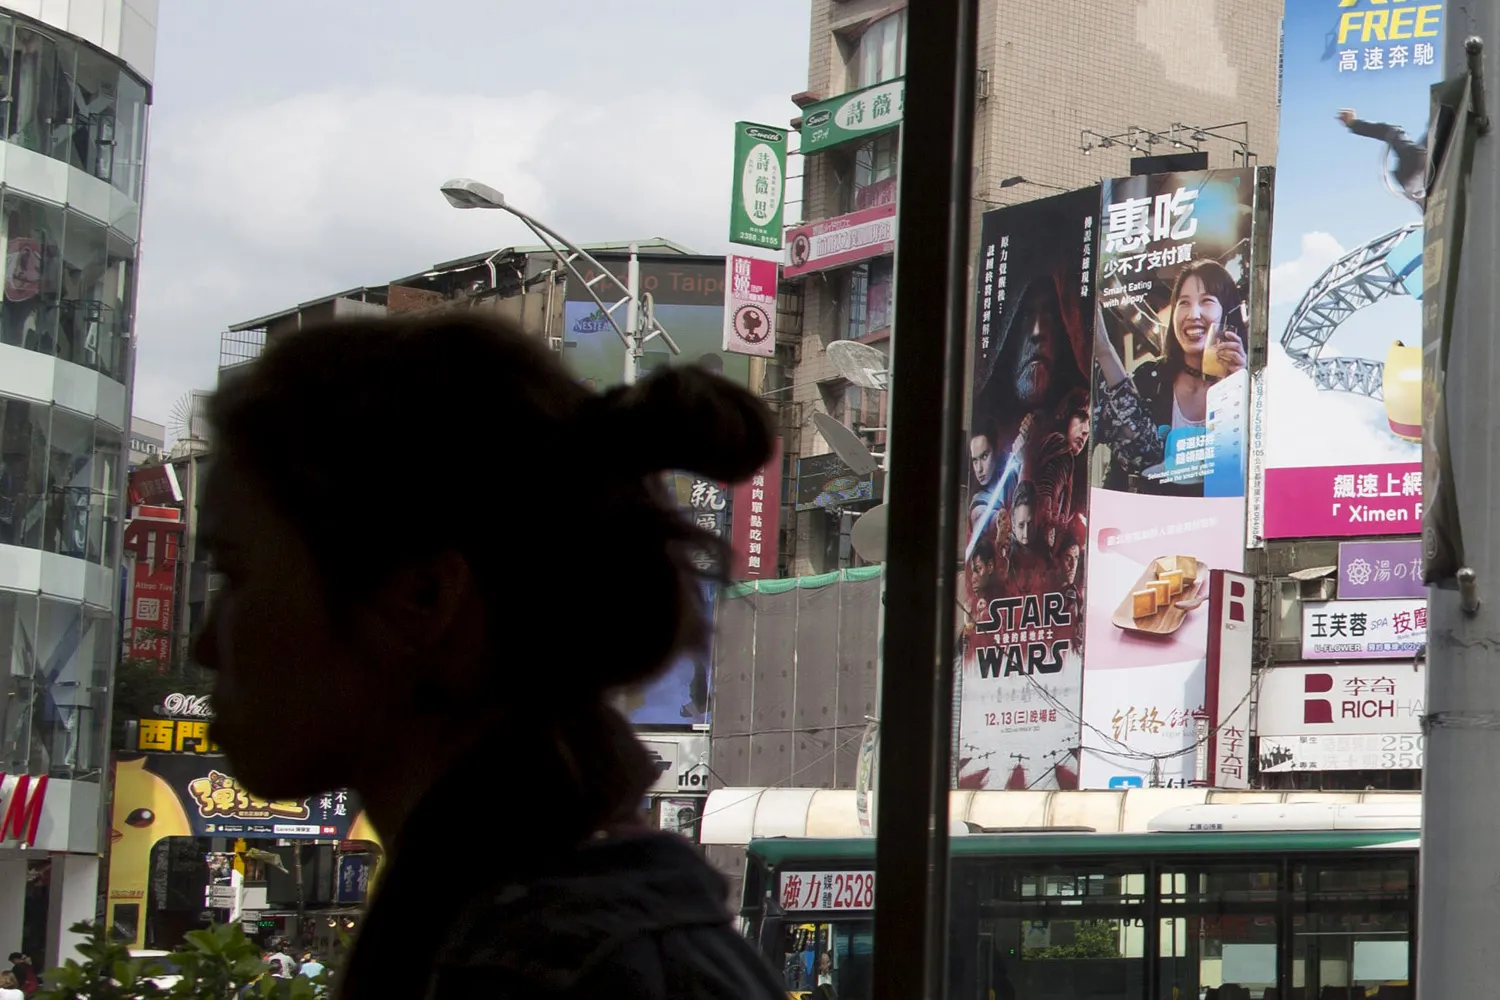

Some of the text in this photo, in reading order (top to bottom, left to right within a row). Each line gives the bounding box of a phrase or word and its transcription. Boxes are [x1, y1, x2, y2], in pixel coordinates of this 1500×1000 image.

[1337, 5, 1442, 44] FREE
[1339, 43, 1434, 72] 高速奔馳
[811, 128, 830, 143] SPA
[753, 152, 771, 219] 詩薇思
[1105, 186, 1199, 253] 惠吃
[1103, 243, 1194, 279] 少不了支付寶
[668, 272, 726, 294] Taipe
[1103, 280, 1152, 296] Smart Eating
[1102, 293, 1145, 308] with Alipay
[1349, 505, 1408, 522] Ximen
[976, 592, 1071, 634] STAR
[1311, 613, 1367, 638] 玉芙蓉
[1371, 618, 1388, 630] SPA
[976, 640, 1071, 679] WARS
[1314, 643, 1362, 652] U-FLOWER
[1343, 677, 1396, 696] 李奇
[1342, 700, 1394, 718] RICH
[139, 719, 218, 752] 西門
[1220, 726, 1245, 780] 李奇
[783, 875, 821, 908] 強力
[834, 874, 873, 907] 2528
